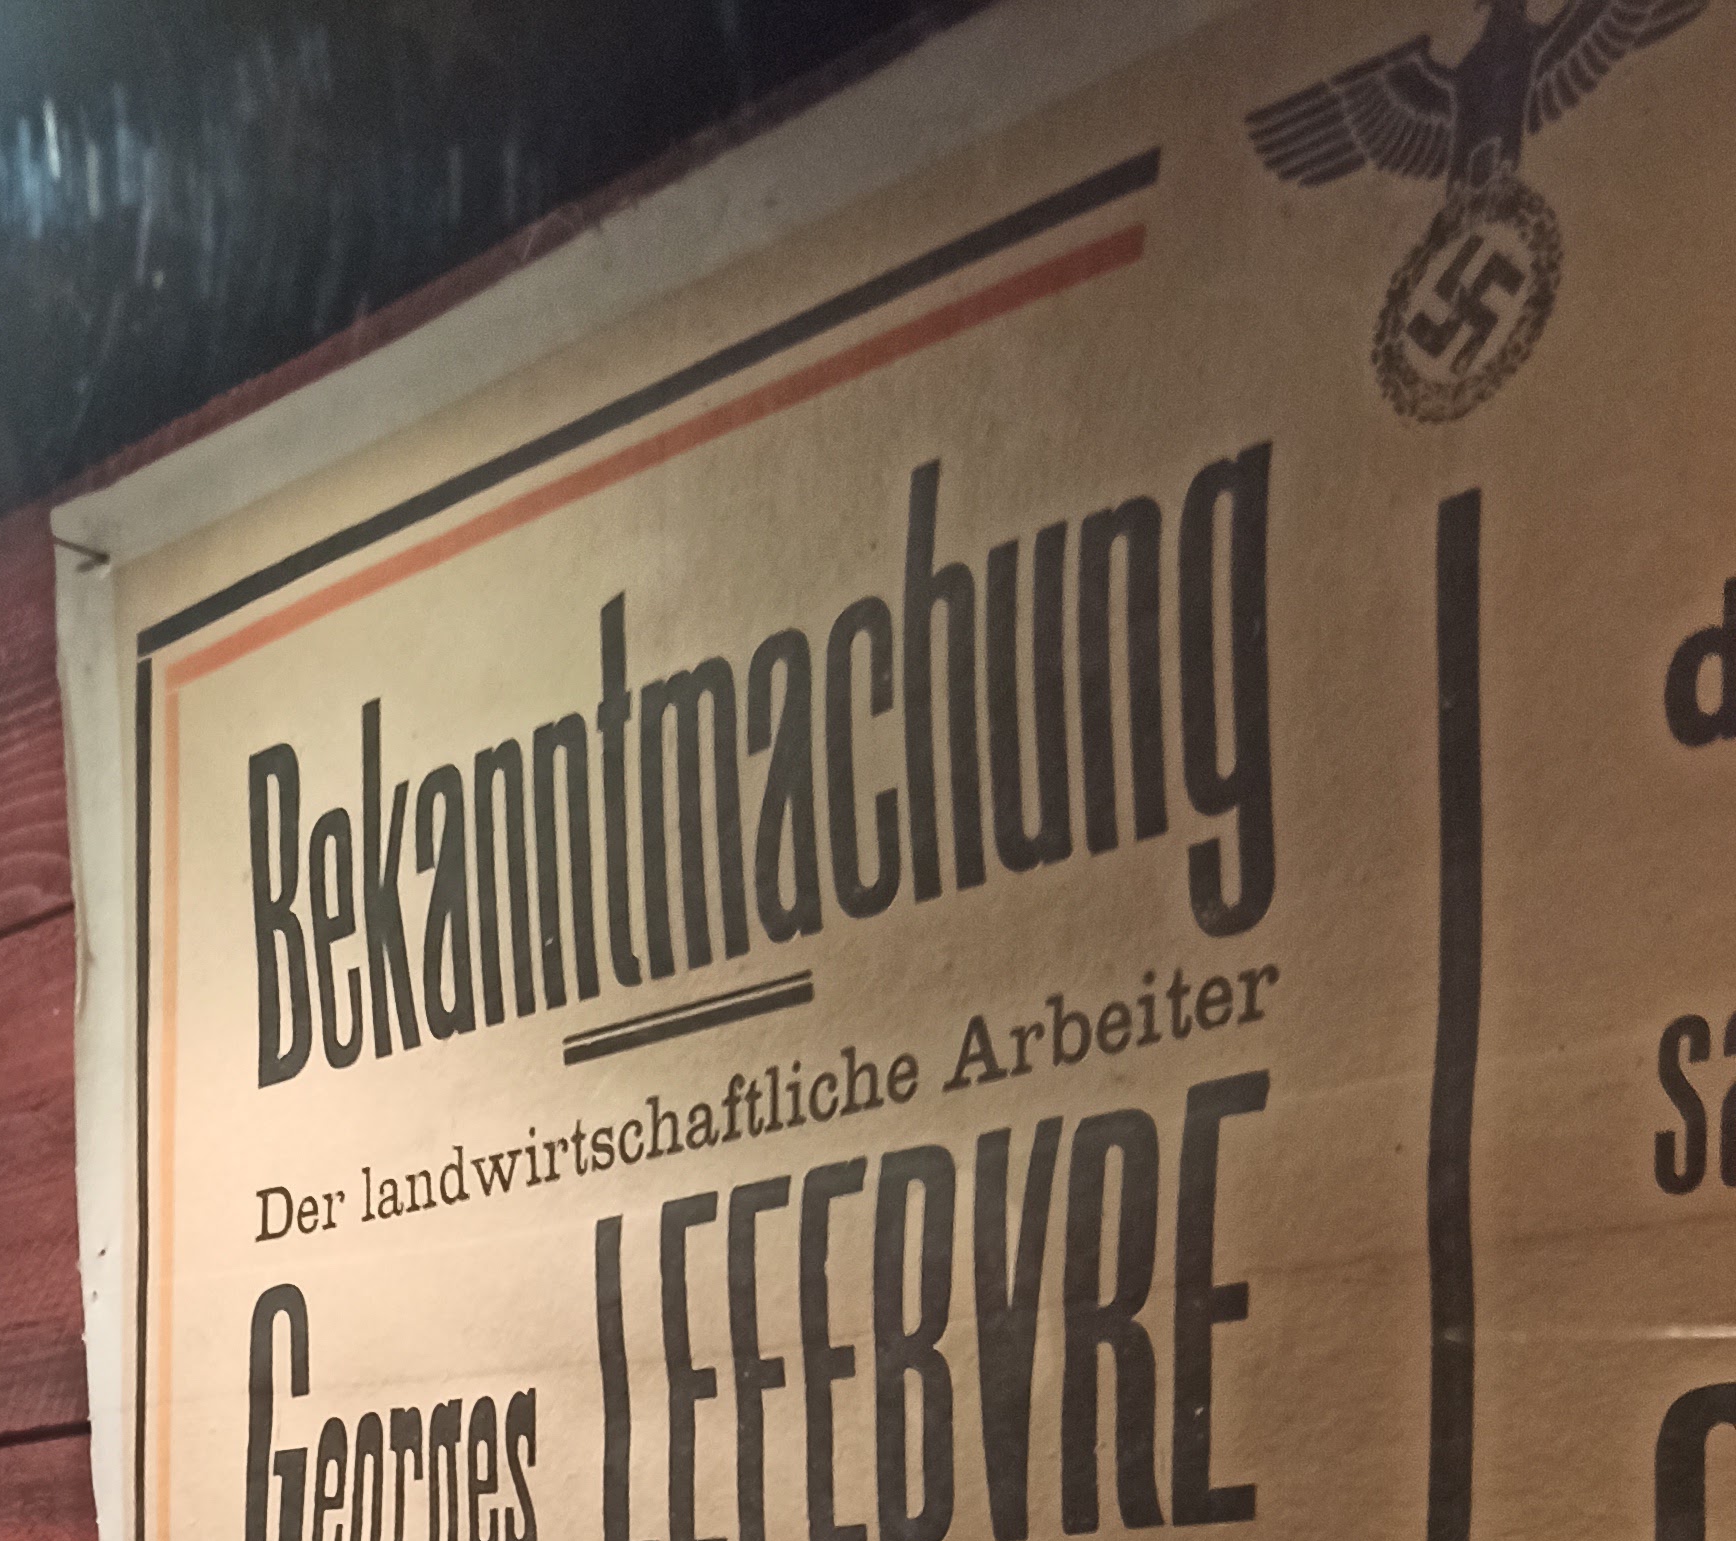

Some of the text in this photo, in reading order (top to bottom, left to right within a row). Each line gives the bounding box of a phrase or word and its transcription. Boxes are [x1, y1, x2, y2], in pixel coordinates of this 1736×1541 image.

[249, 440, 1273, 1088] Bekanntmachung
[255, 963, 1279, 1243] Der landwirtschaftliche Arbeiter
